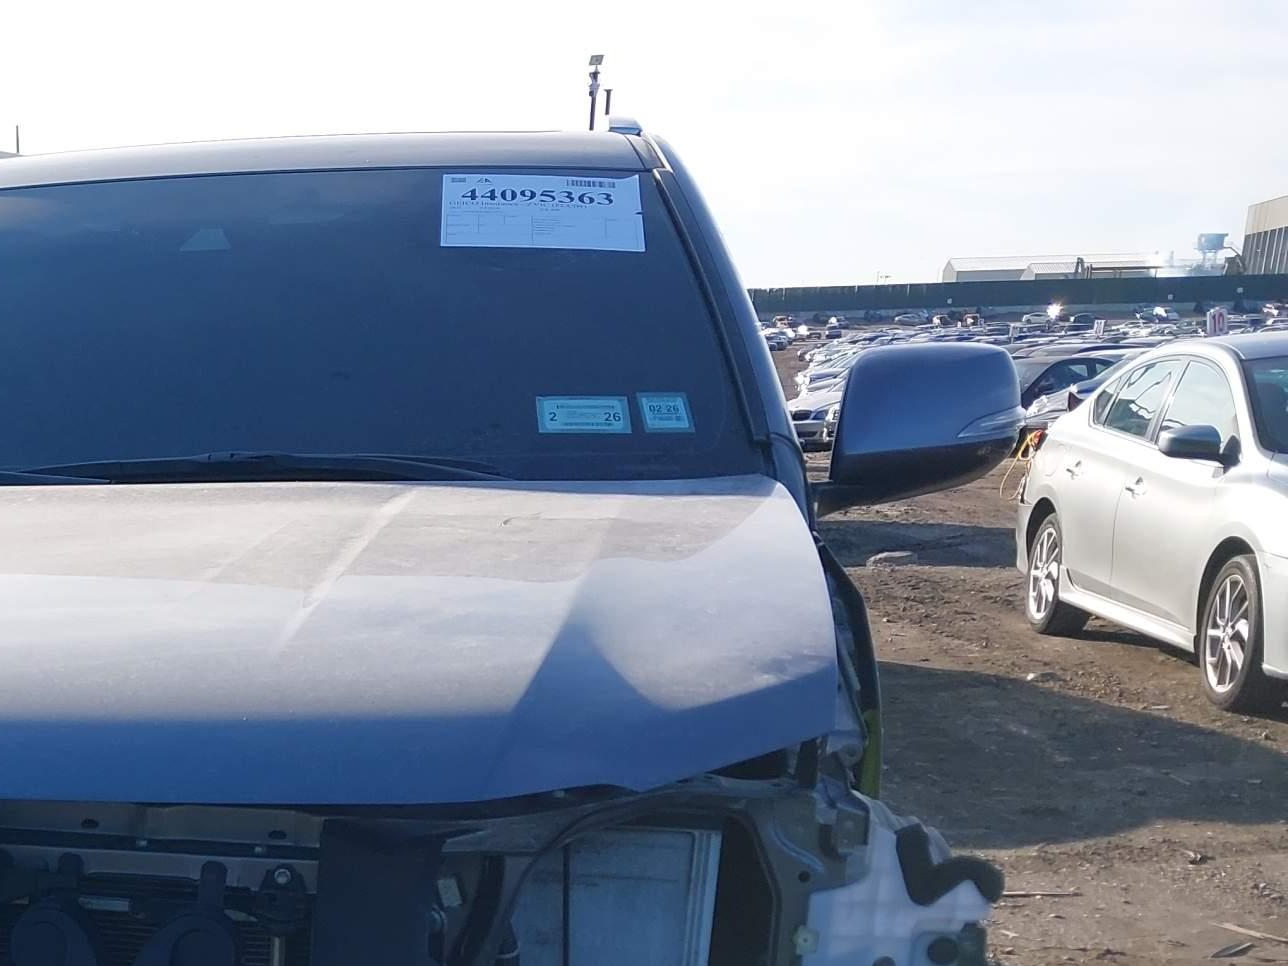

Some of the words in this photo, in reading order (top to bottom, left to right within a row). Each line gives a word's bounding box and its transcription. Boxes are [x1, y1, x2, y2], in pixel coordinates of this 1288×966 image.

[461, 188, 614, 206] 44095363
[1211, 311, 1225, 333] 10
[548, 411, 558, 422] 2
[603, 411, 621, 422] 26
